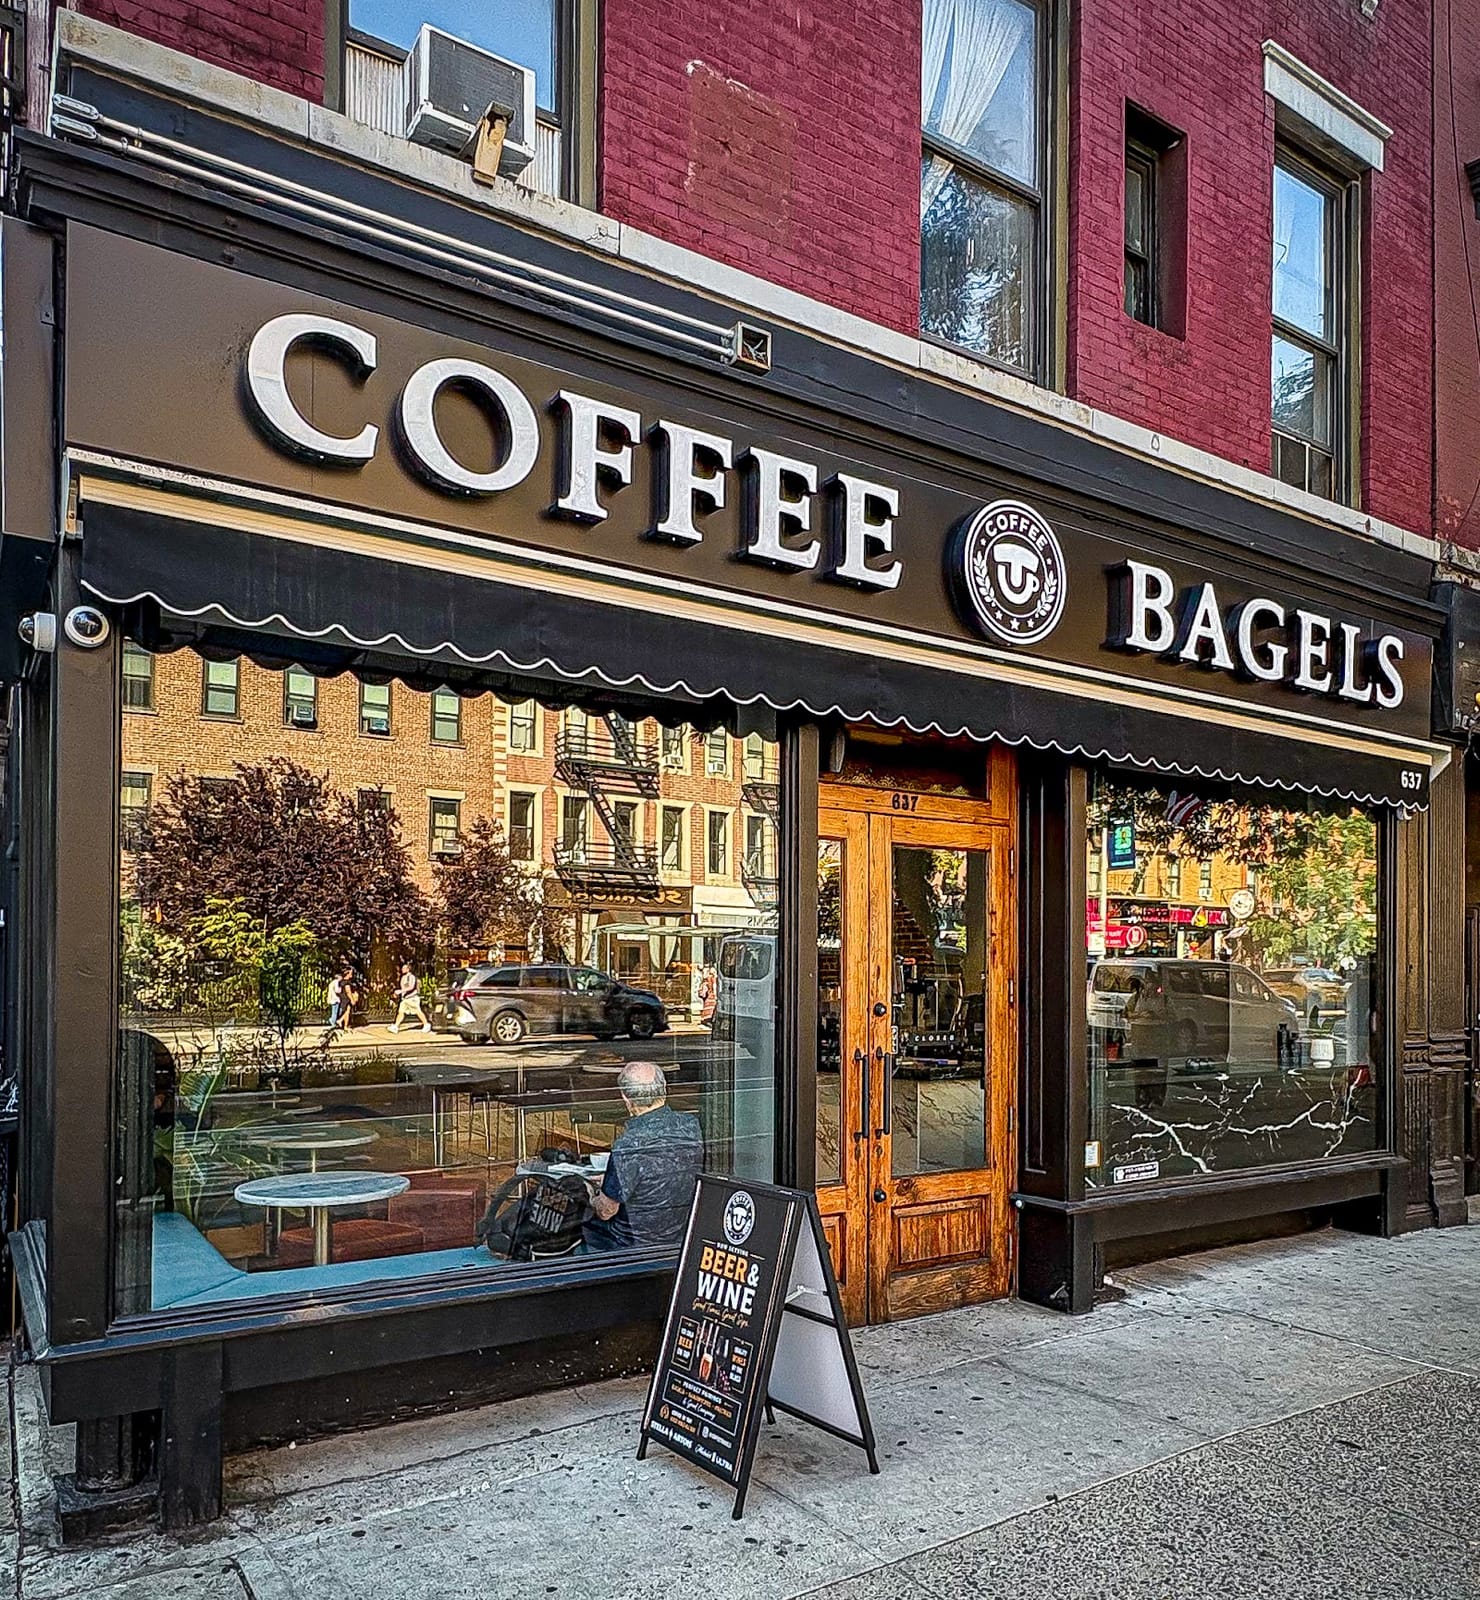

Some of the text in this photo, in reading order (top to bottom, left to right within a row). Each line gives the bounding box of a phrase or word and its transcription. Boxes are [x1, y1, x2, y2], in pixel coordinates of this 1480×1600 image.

[247, 313, 1406, 710] COFFEE BAGELS
[985, 514, 1048, 551] COFFEE
[1401, 770, 1422, 790] 637
[892, 793, 918, 811] 637
[700, 1246, 760, 1287] BEER &
[697, 1270, 755, 1315] WINE
[650, 1420, 669, 1435] STELLA
